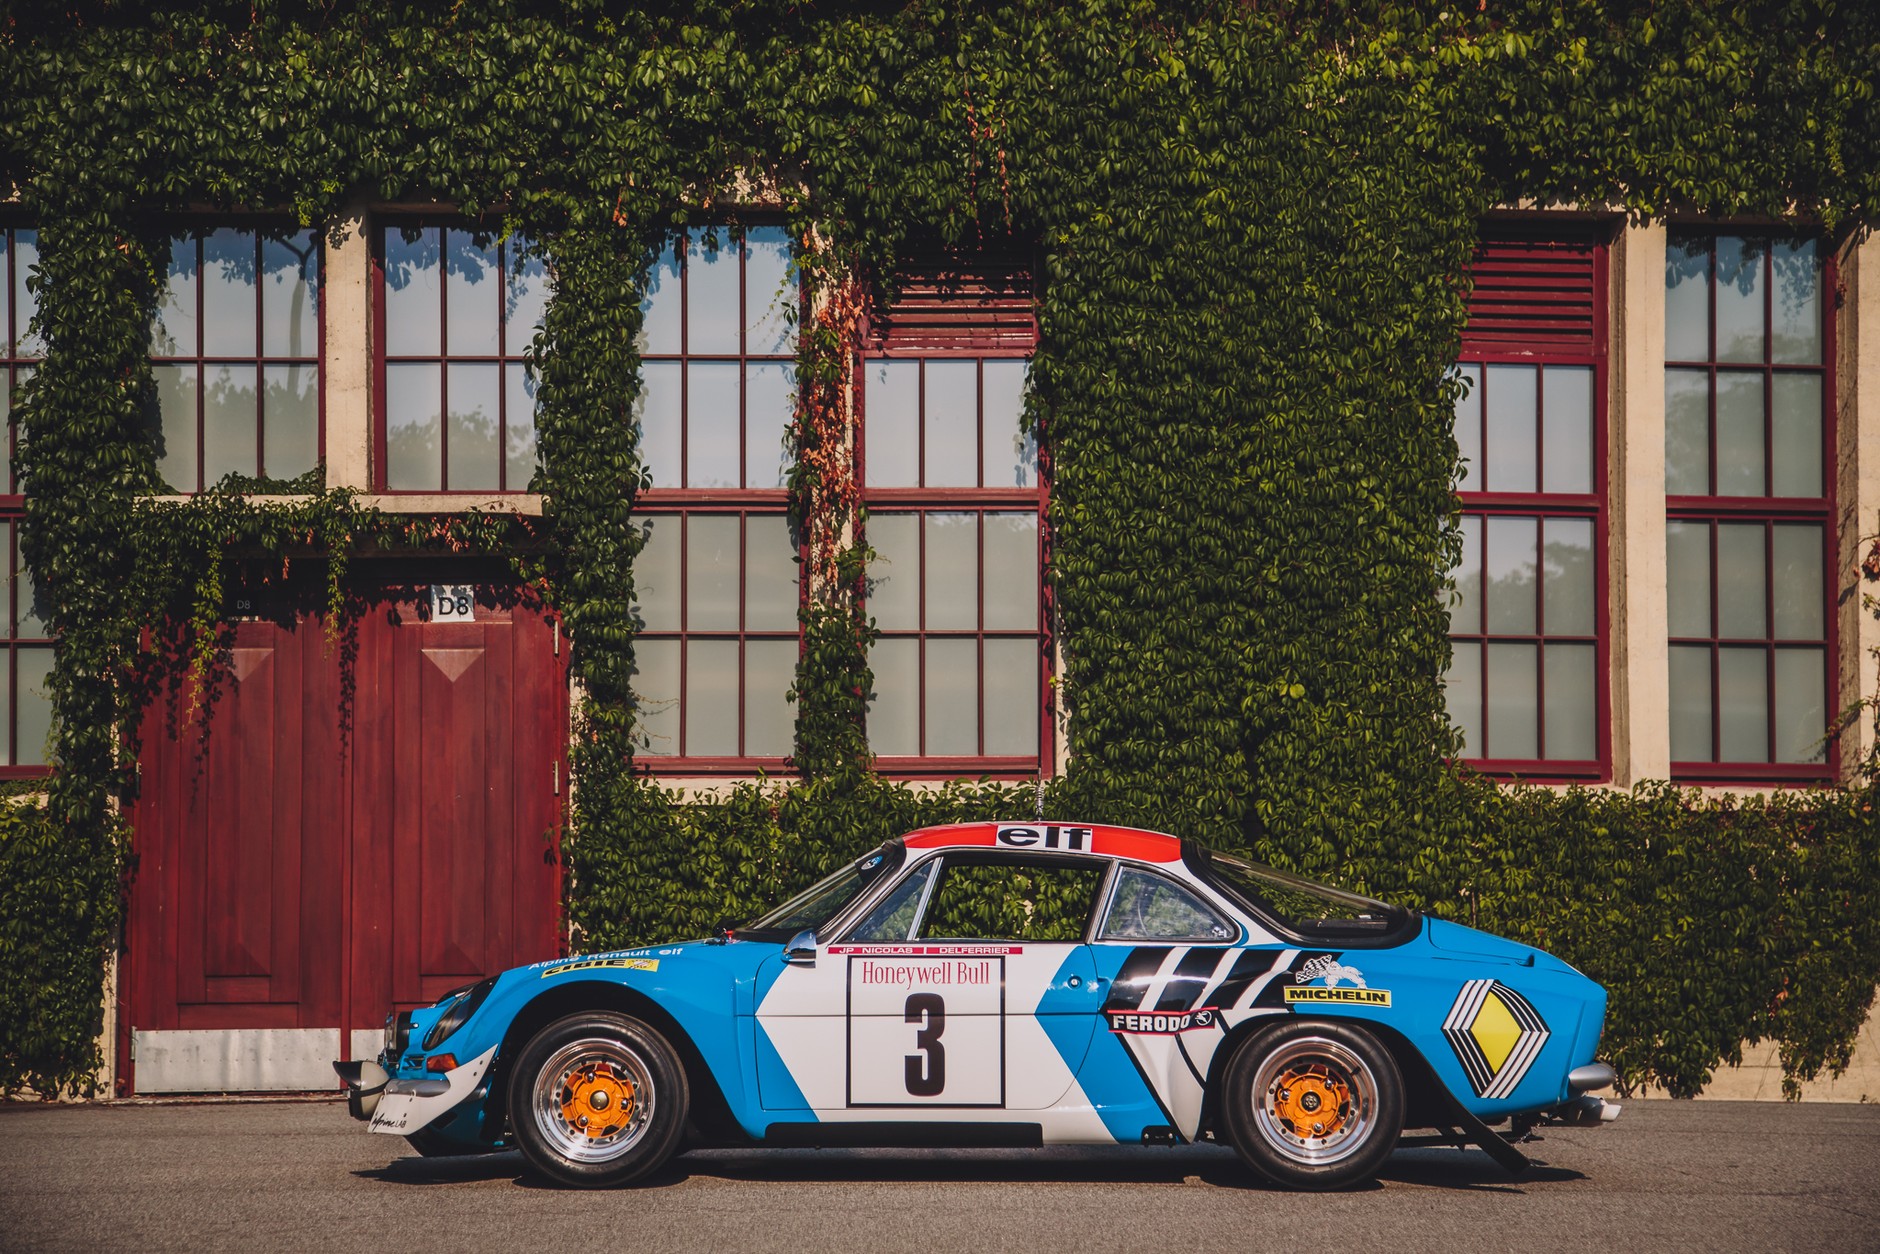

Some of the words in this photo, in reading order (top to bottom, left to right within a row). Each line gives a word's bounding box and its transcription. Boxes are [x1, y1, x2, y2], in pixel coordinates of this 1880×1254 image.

[237, 600, 251, 609] D8
[439, 597, 469, 615] D8
[998, 826, 1092, 850] elf
[528, 955, 579, 970] Alpine
[587, 950, 651, 960] Renault
[862, 962, 951, 990] Honeywell
[957, 962, 990, 984] Bull
[1289, 990, 1386, 1002] MICHELIN
[1113, 1014, 1191, 1032] FERODO
[904, 992, 945, 1096] 3
